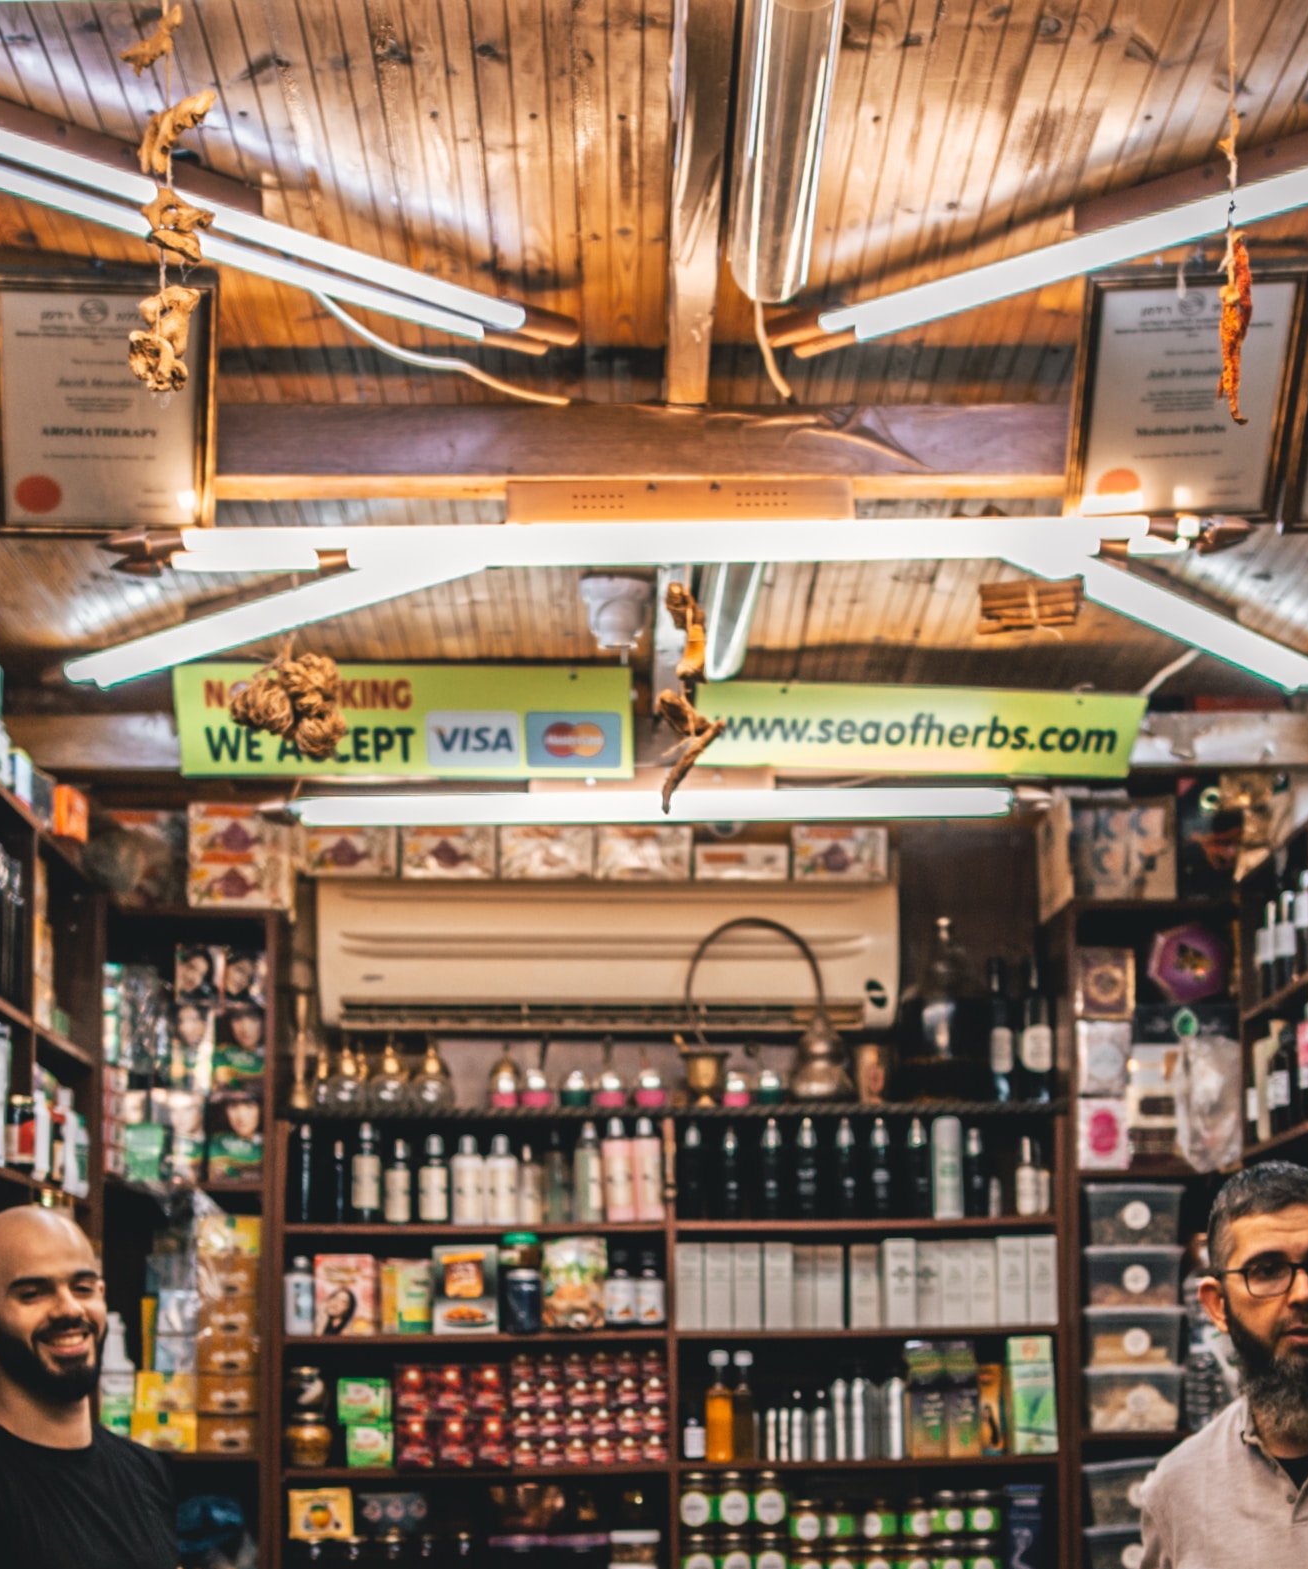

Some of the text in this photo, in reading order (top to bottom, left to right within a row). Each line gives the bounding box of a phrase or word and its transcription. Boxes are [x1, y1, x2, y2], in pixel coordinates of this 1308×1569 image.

[41, 427, 157, 438] AROMATHERAPY
[1136, 424, 1226, 437] Medicinal Herbs
[204, 726, 415, 762] WE ACEPT
[435, 727, 514, 752] VISA
[715, 712, 1117, 754] www.seaofherbs.com
